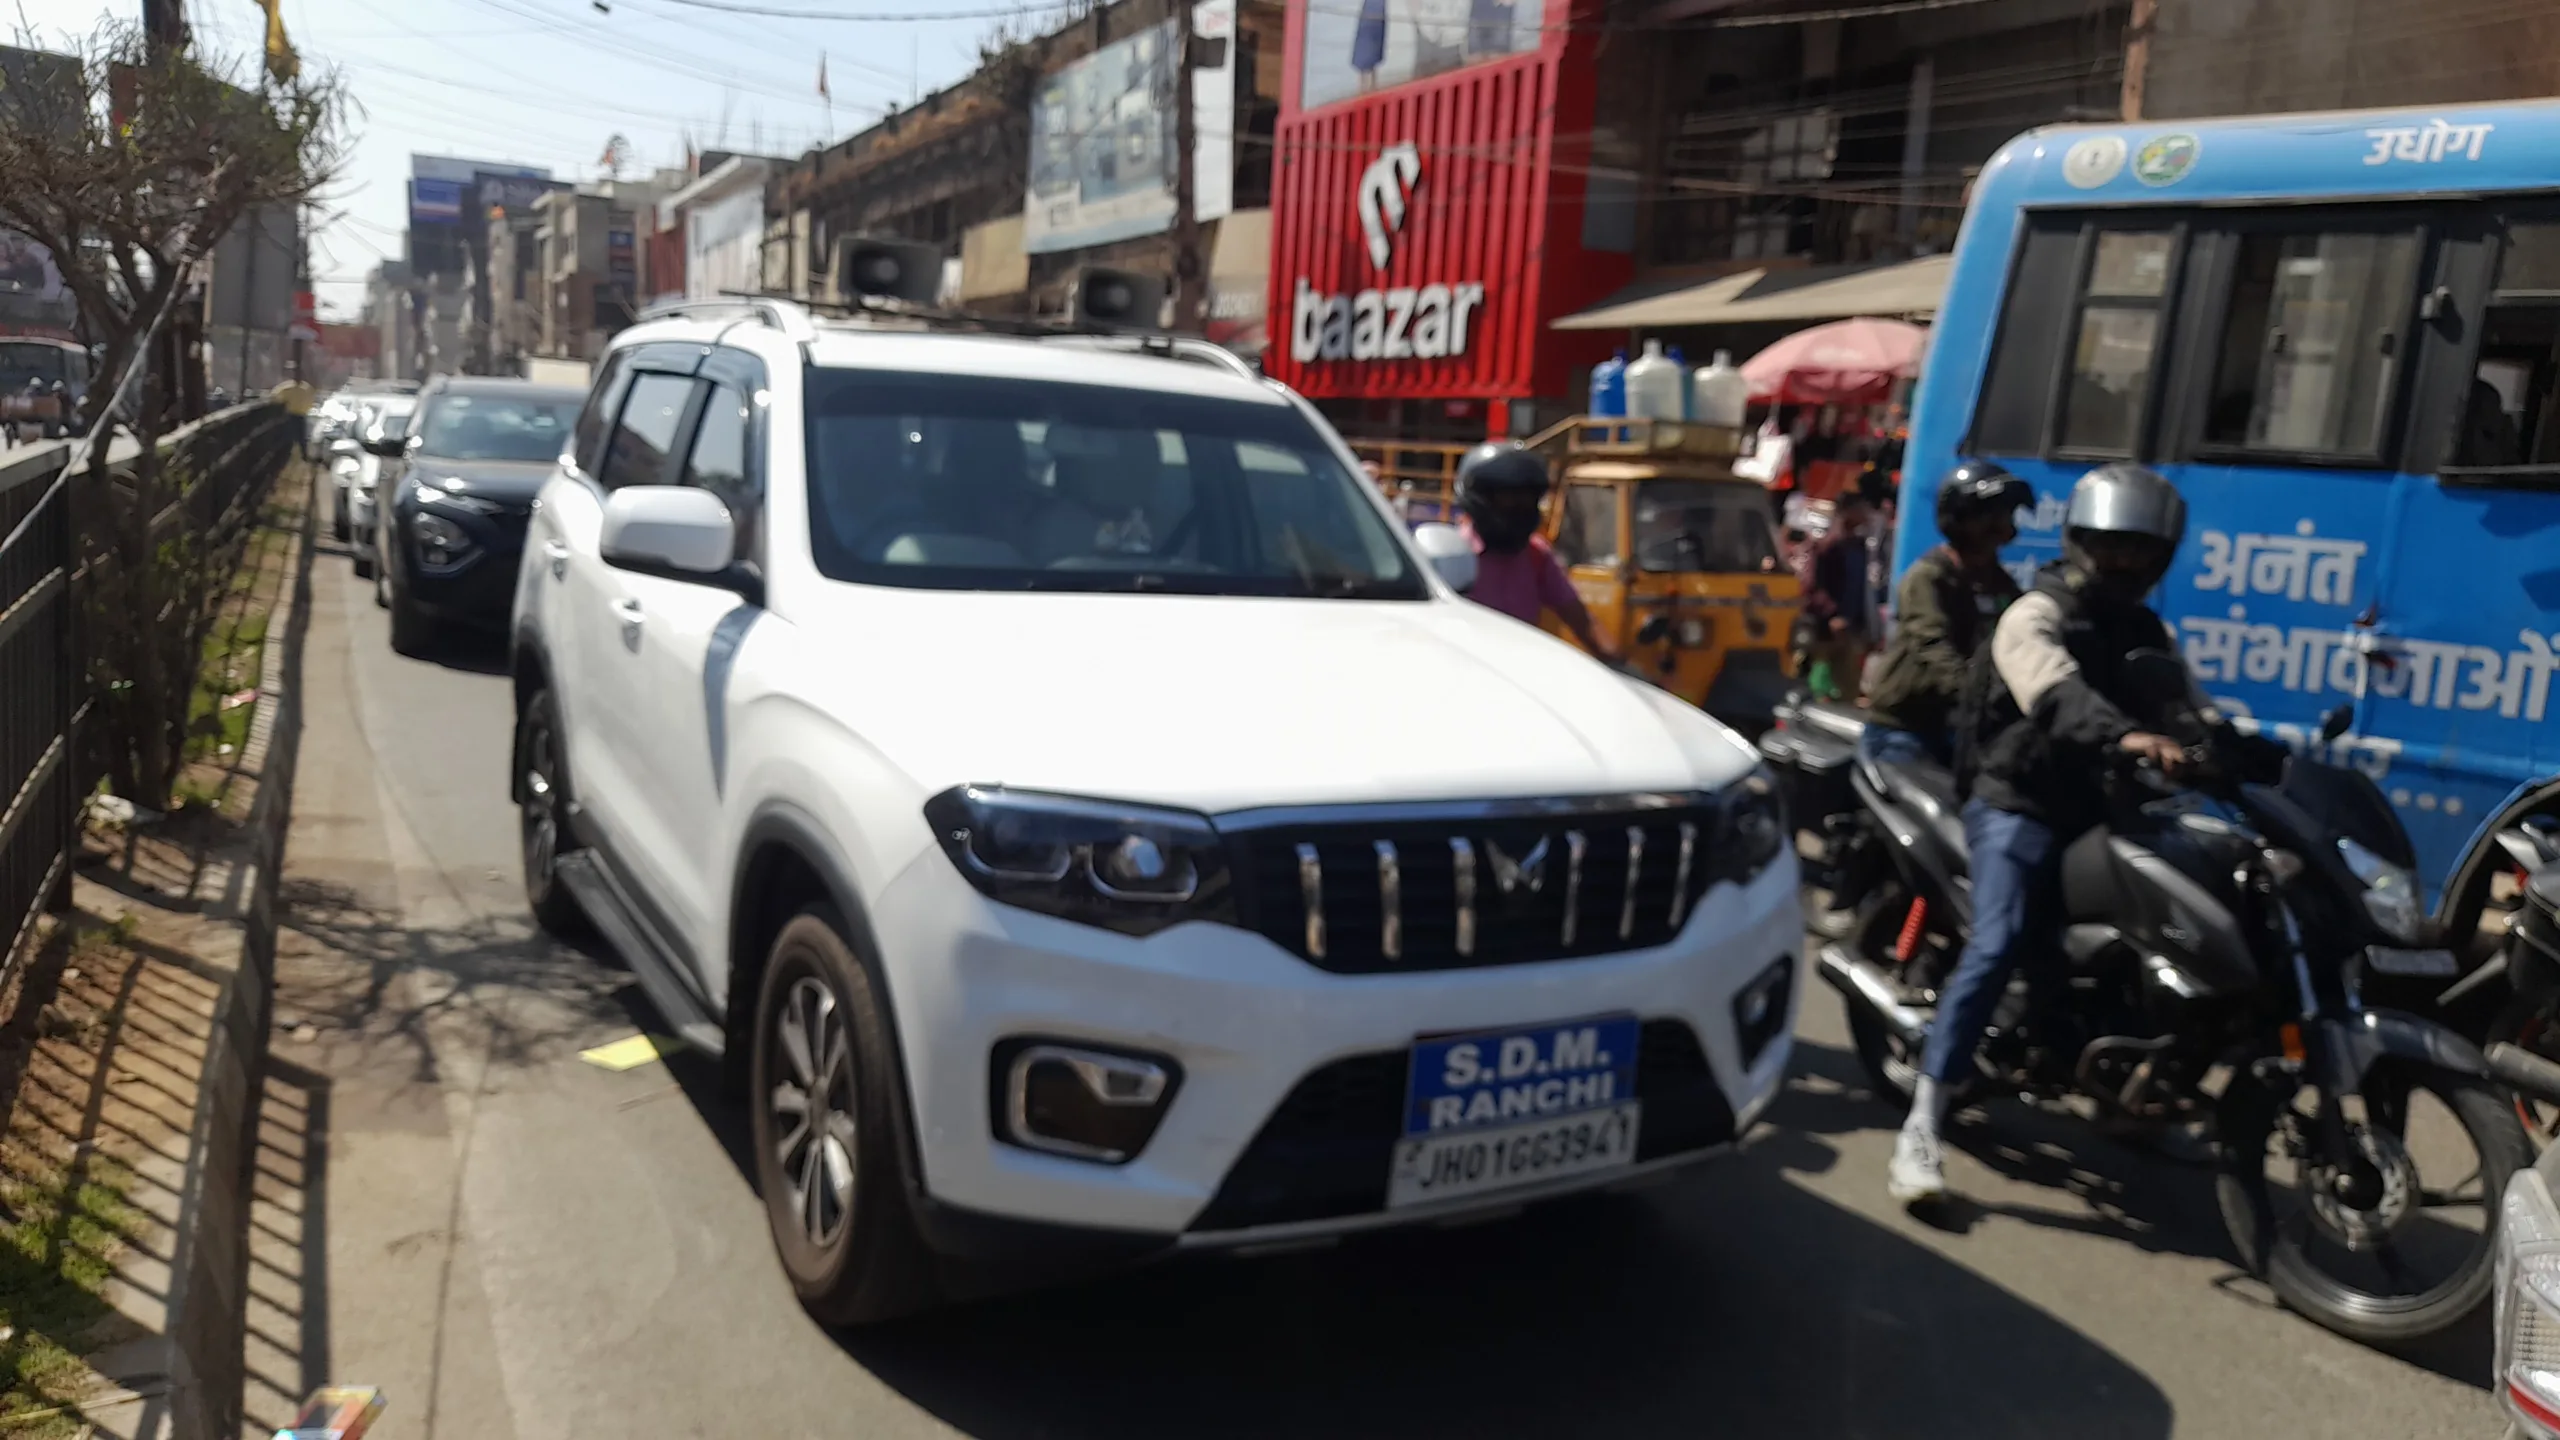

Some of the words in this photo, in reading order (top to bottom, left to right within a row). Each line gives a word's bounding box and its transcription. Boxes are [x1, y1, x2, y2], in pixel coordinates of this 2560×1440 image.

[1290, 275, 1485, 364] baazar
[2193, 518, 2368, 607] अनंत
[1442, 1026, 1612, 1088] S.D.M.
[1428, 1070, 1615, 1129] RANCHI
